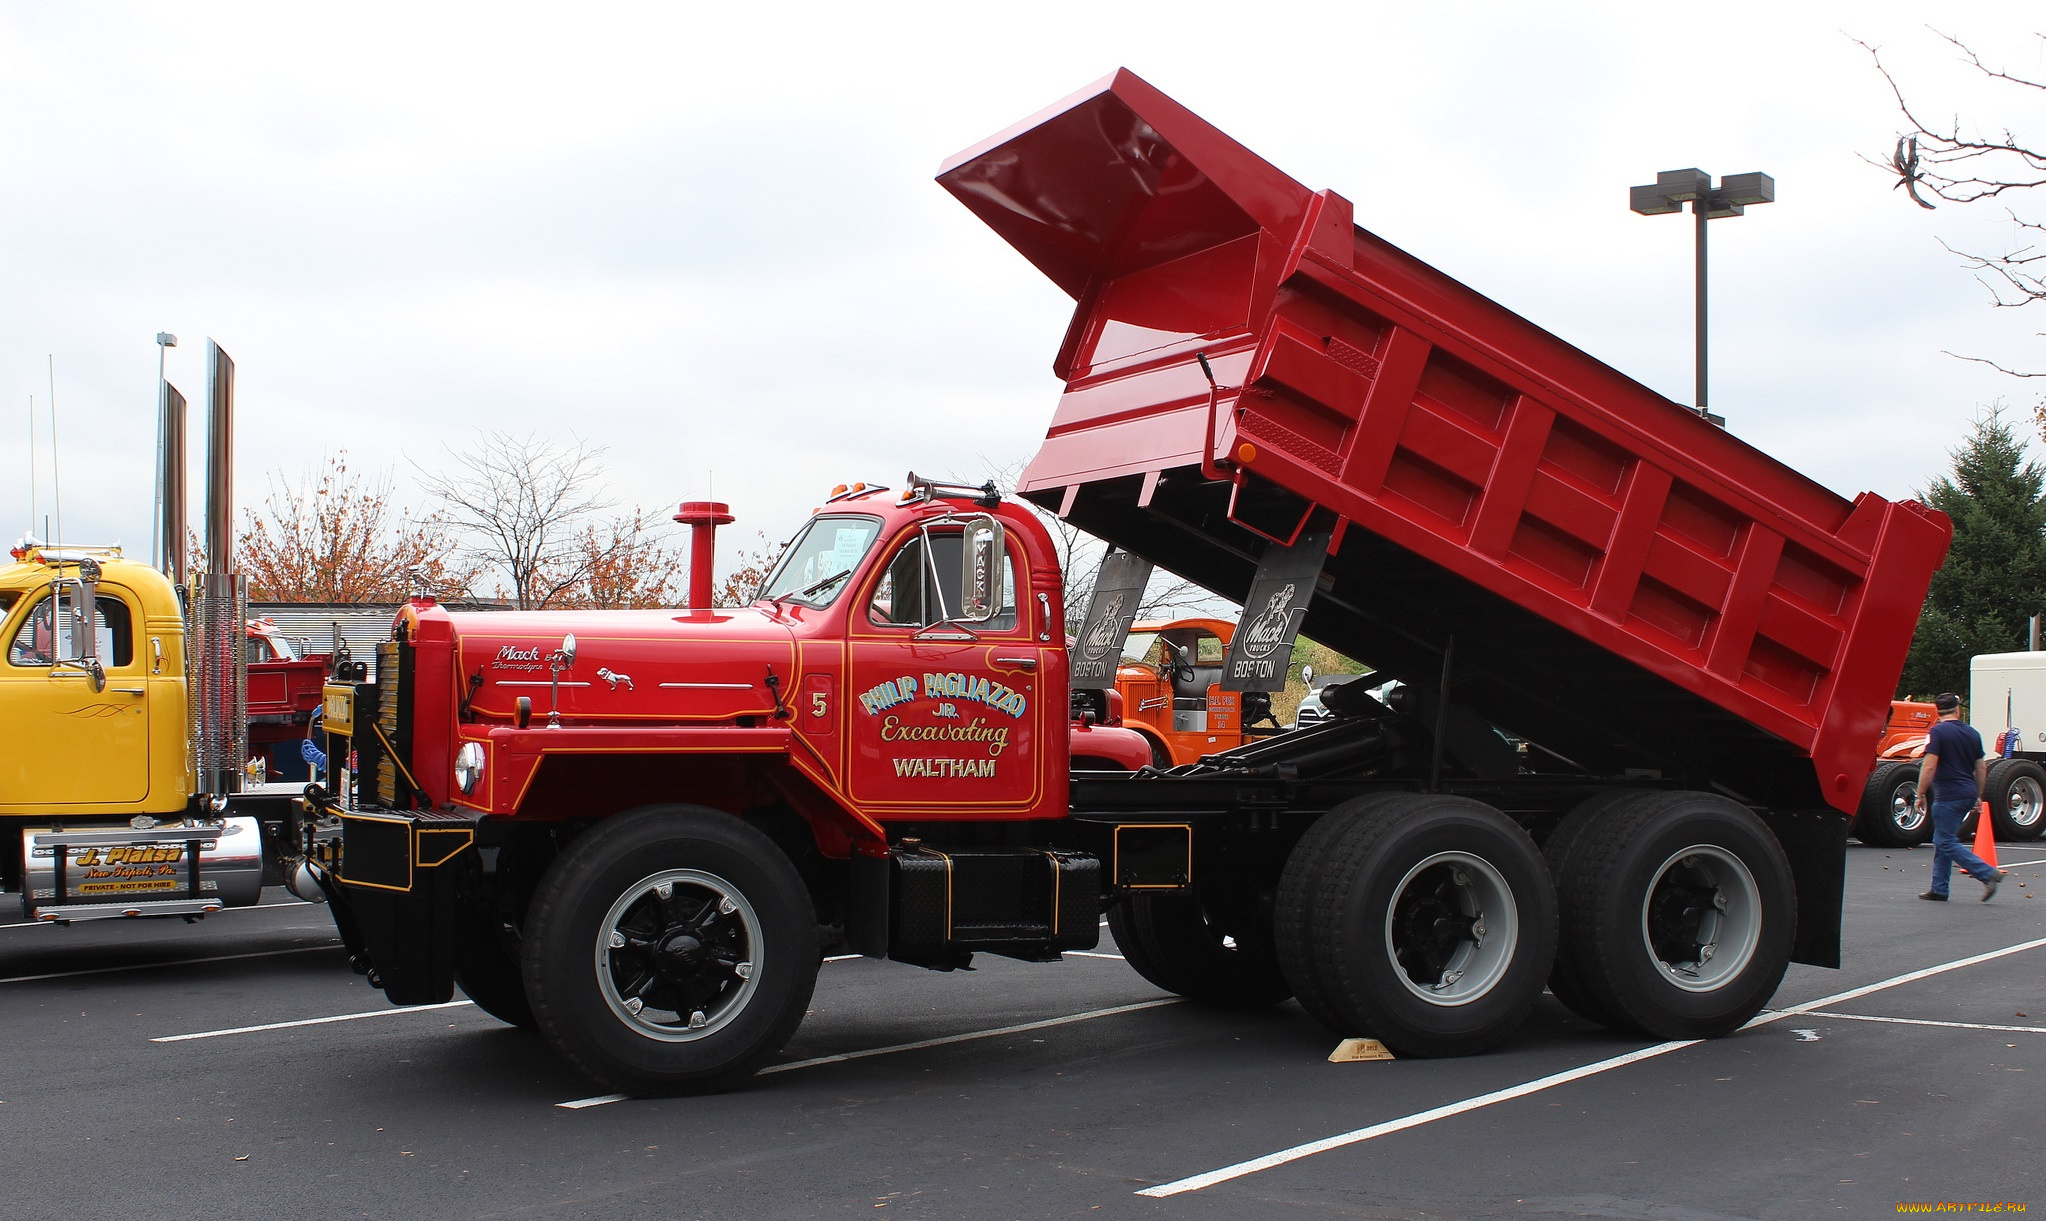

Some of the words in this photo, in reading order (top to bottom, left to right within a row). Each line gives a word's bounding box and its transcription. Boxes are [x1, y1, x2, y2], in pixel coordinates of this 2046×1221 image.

[1085, 626, 1114, 647] Mack
[1246, 621, 1281, 643] Mack
[495, 645, 540, 661] Mack
[1249, 644, 1271, 652] TRUCKS
[1074, 661, 1108, 677] BOSTON
[1234, 660, 1276, 678] BOSTON
[811, 692, 827, 717] 5
[858, 676, 918, 715] PHILIP
[923, 672, 1026, 718] PAGLIAZZO
[932, 703, 959, 718] JR.
[880, 715, 1010, 757] Excavating
[893, 758, 997, 777] WALTHAM
[76, 849, 101, 866] J.
[105, 846, 183, 865] Plaksa
[82, 867, 111, 879] New
